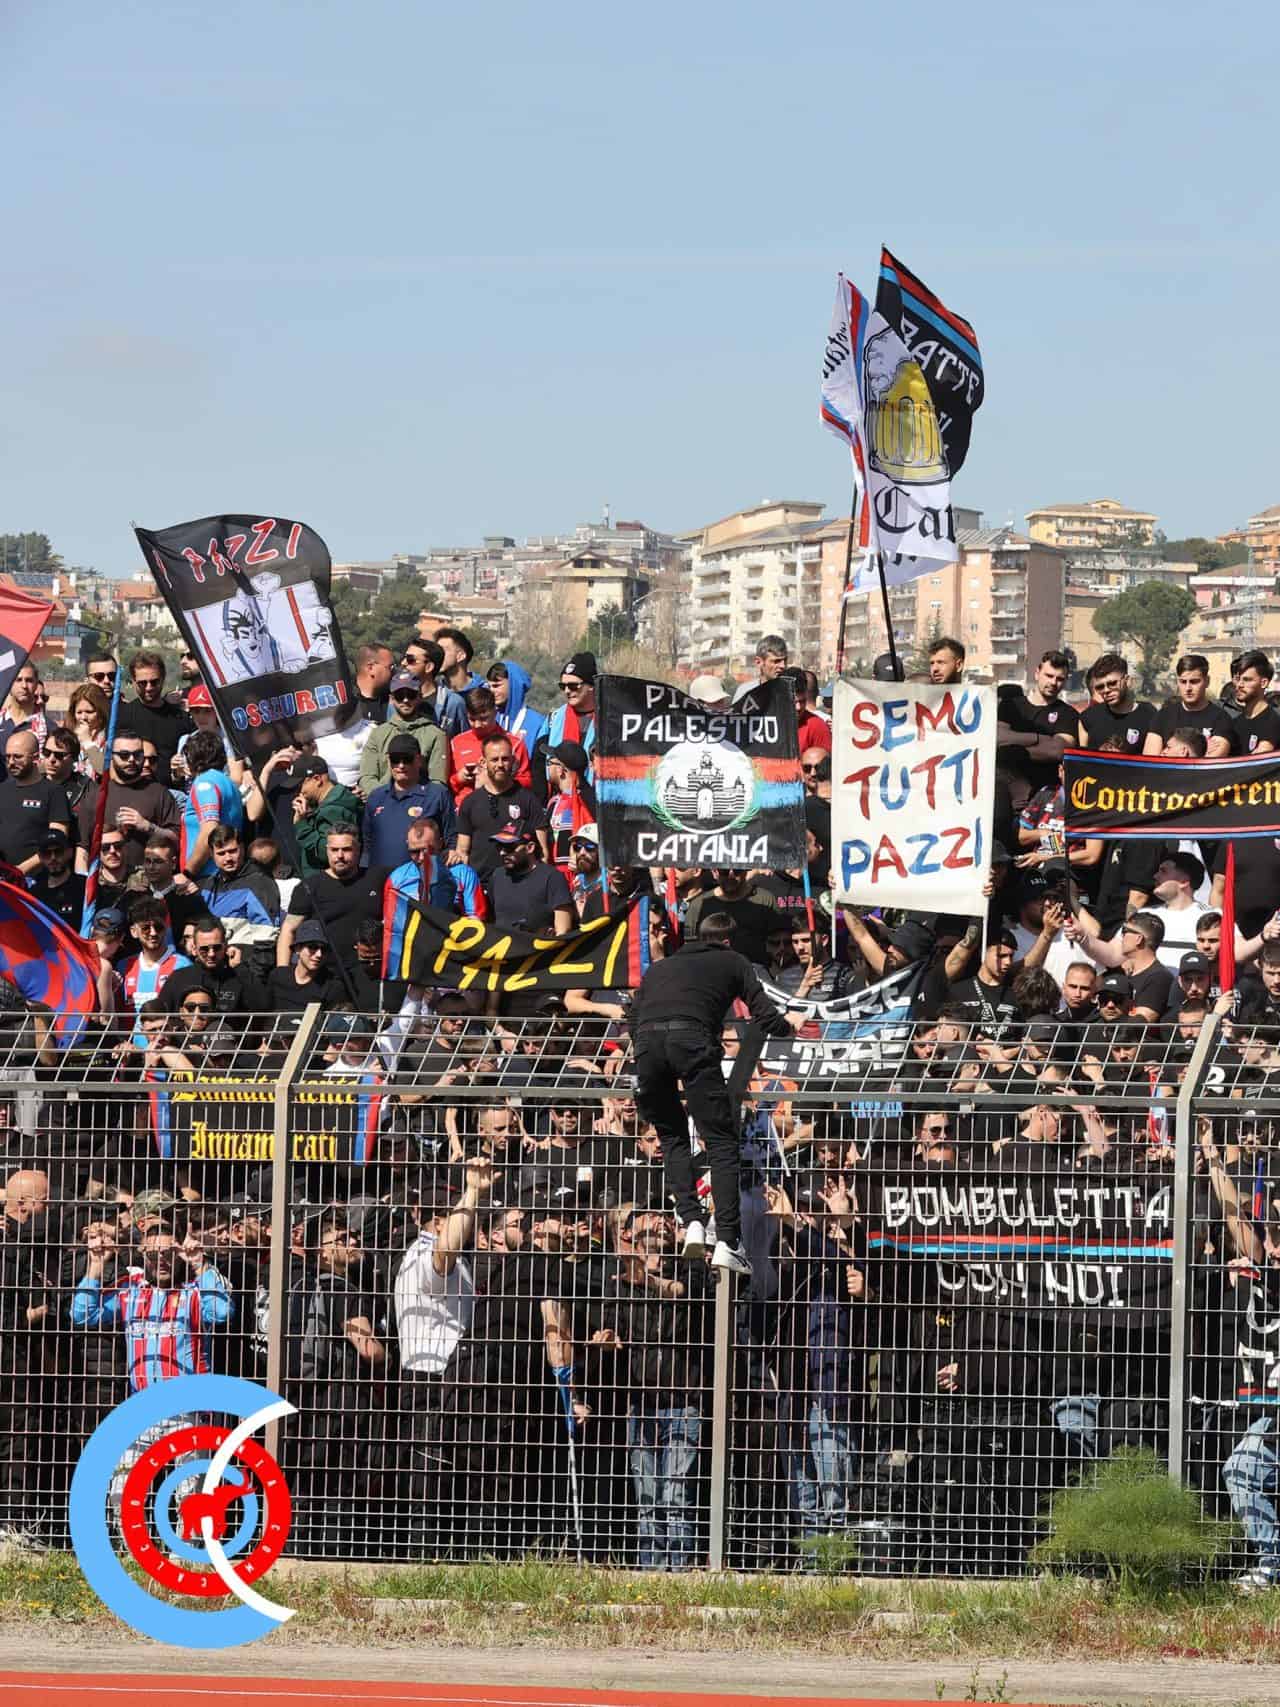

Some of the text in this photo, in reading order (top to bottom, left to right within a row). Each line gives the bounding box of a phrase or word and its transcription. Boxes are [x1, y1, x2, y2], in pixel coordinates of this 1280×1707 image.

[182, 519, 302, 583] PAZZI
[621, 713, 779, 744] PALESTRO
[852, 689, 983, 752] SEMU
[843, 747, 980, 821] TUTTI
[637, 832, 769, 864] CATANIA
[841, 816, 983, 893] PAZZI
[401, 908, 628, 991] I PAZZI
[191, 1119, 337, 1160] Innamrati
